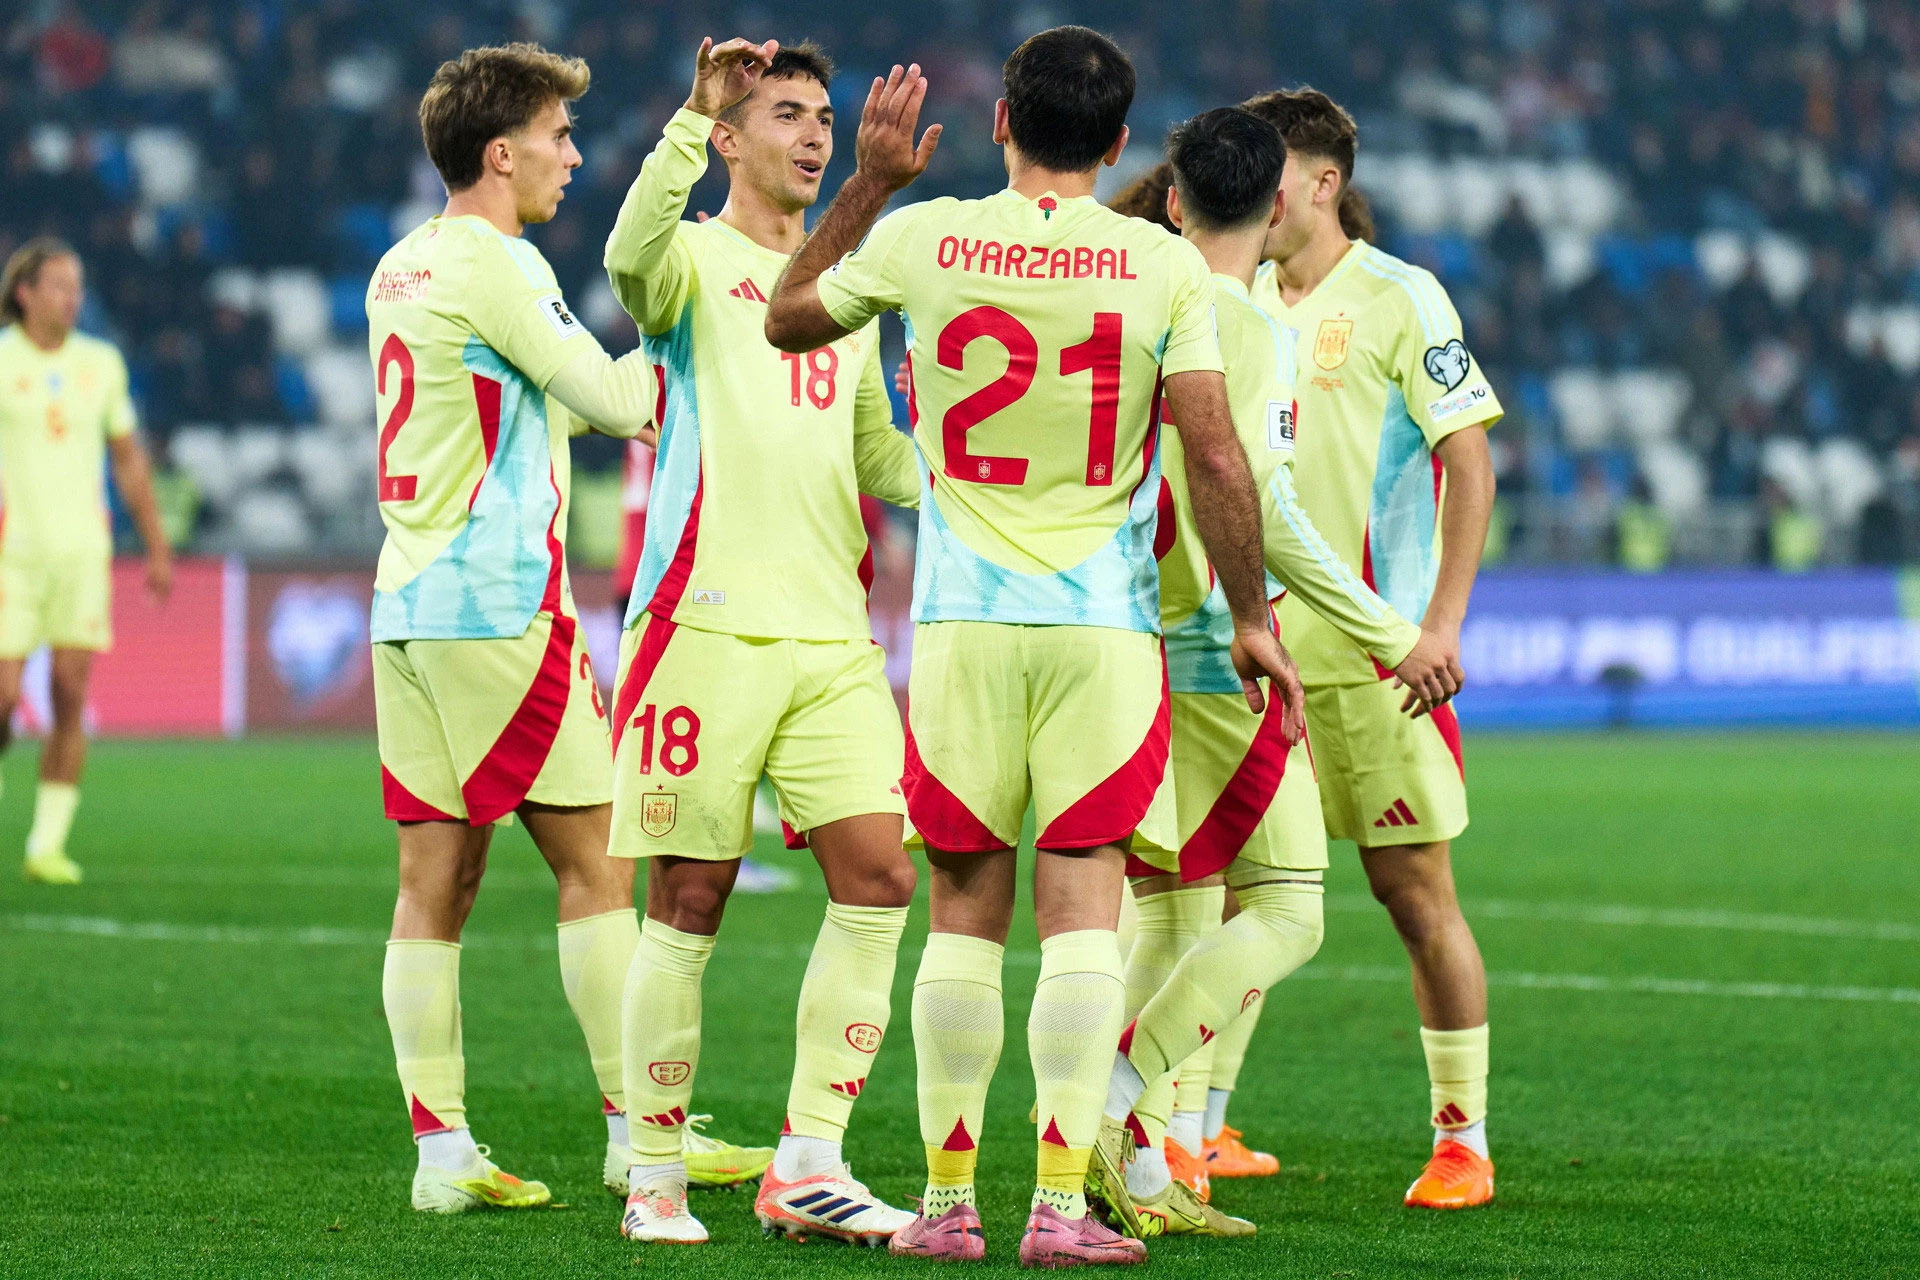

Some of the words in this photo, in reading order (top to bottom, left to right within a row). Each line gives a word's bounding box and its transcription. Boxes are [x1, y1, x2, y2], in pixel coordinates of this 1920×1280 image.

[938, 236, 1137, 280] OYARZABAL
[781, 345, 838, 410] 18
[938, 305, 1123, 486] 21
[378, 333, 418, 502] 2
[632, 704, 701, 777] 18
